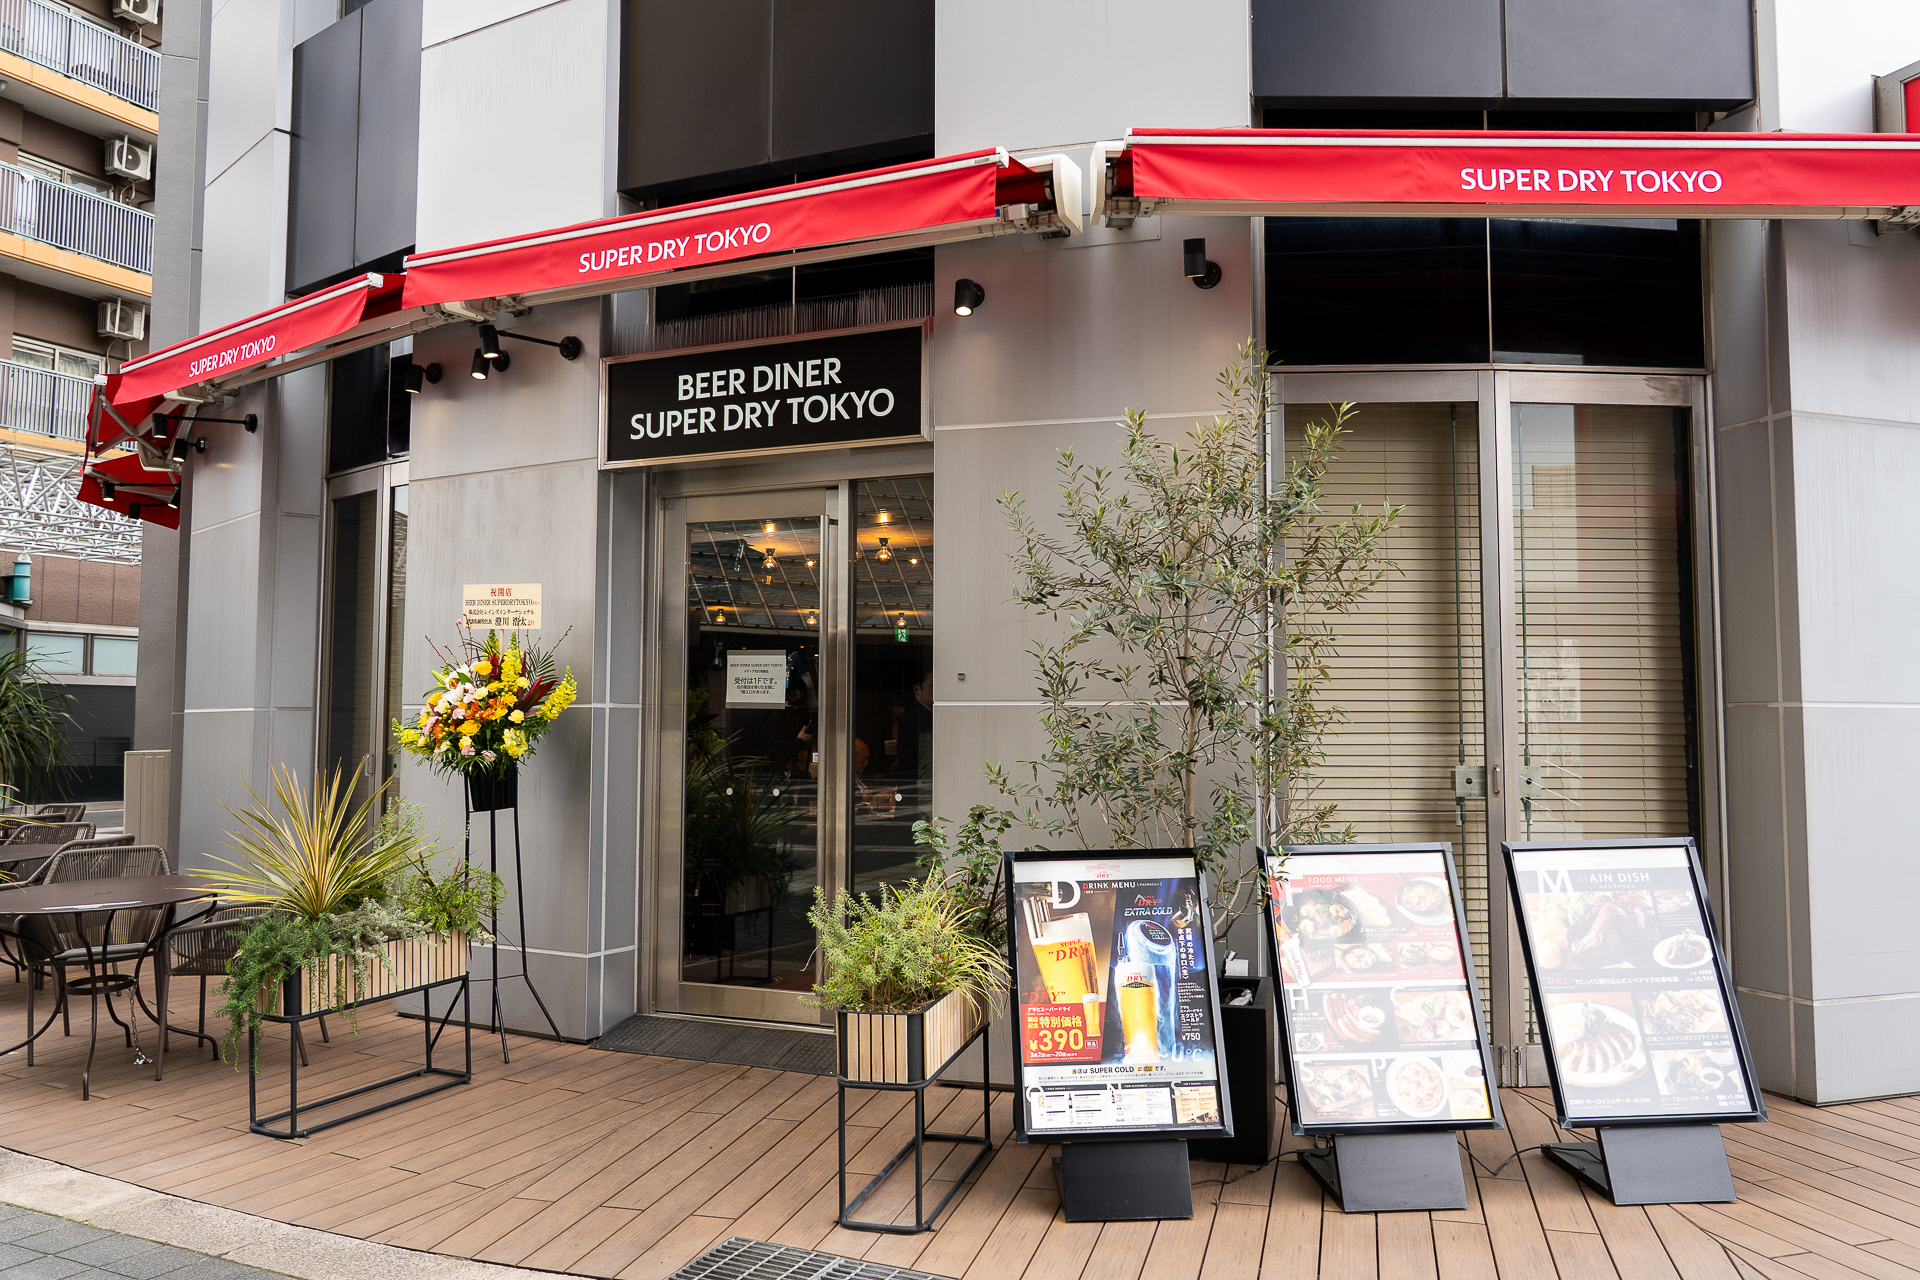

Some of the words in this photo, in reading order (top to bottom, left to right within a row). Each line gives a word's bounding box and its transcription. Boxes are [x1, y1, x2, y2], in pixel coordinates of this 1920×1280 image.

[1461, 168, 1552, 192] SUPER
[1558, 169, 1613, 192] DRY
[1620, 169, 1722, 193] TOKYO
[578, 245, 643, 273] SUPER
[647, 237, 690, 262] DRY
[694, 222, 771, 254] TOKYO
[188, 354, 219, 379] SUPER
[217, 345, 241, 368] DRY
[239, 334, 277, 362] TOKYO
[678, 368, 746, 401] BEER
[753, 357, 842, 393] DINER
[630, 407, 717, 440] SUPER
[723, 399, 781, 431] DRY
[786, 388, 895, 425] TOKYO
[490, 587, 512, 597] 祝開店
[734, 676, 777, 685] 受付は1Fです。
[1577, 873, 1613, 883] MAIN
[1617, 872, 1650, 883] DISH
[1082, 882, 1109, 890] DRINK
[1111, 881, 1136, 889] MENU
[1124, 907, 1151, 916] EXTRA
[1151, 906, 1173, 916] COLD
[1060, 938, 1082, 948] SUPER
[1039, 1015, 1083, 1028] 特別価格
[1029, 1028, 1084, 1052] ¥390
[1181, 1032, 1201, 1041] ¥750
[1585, 1097, 1631, 1105] サーロインステーキ
[1660, 1095, 1710, 1103] ビーフカットステーキ
